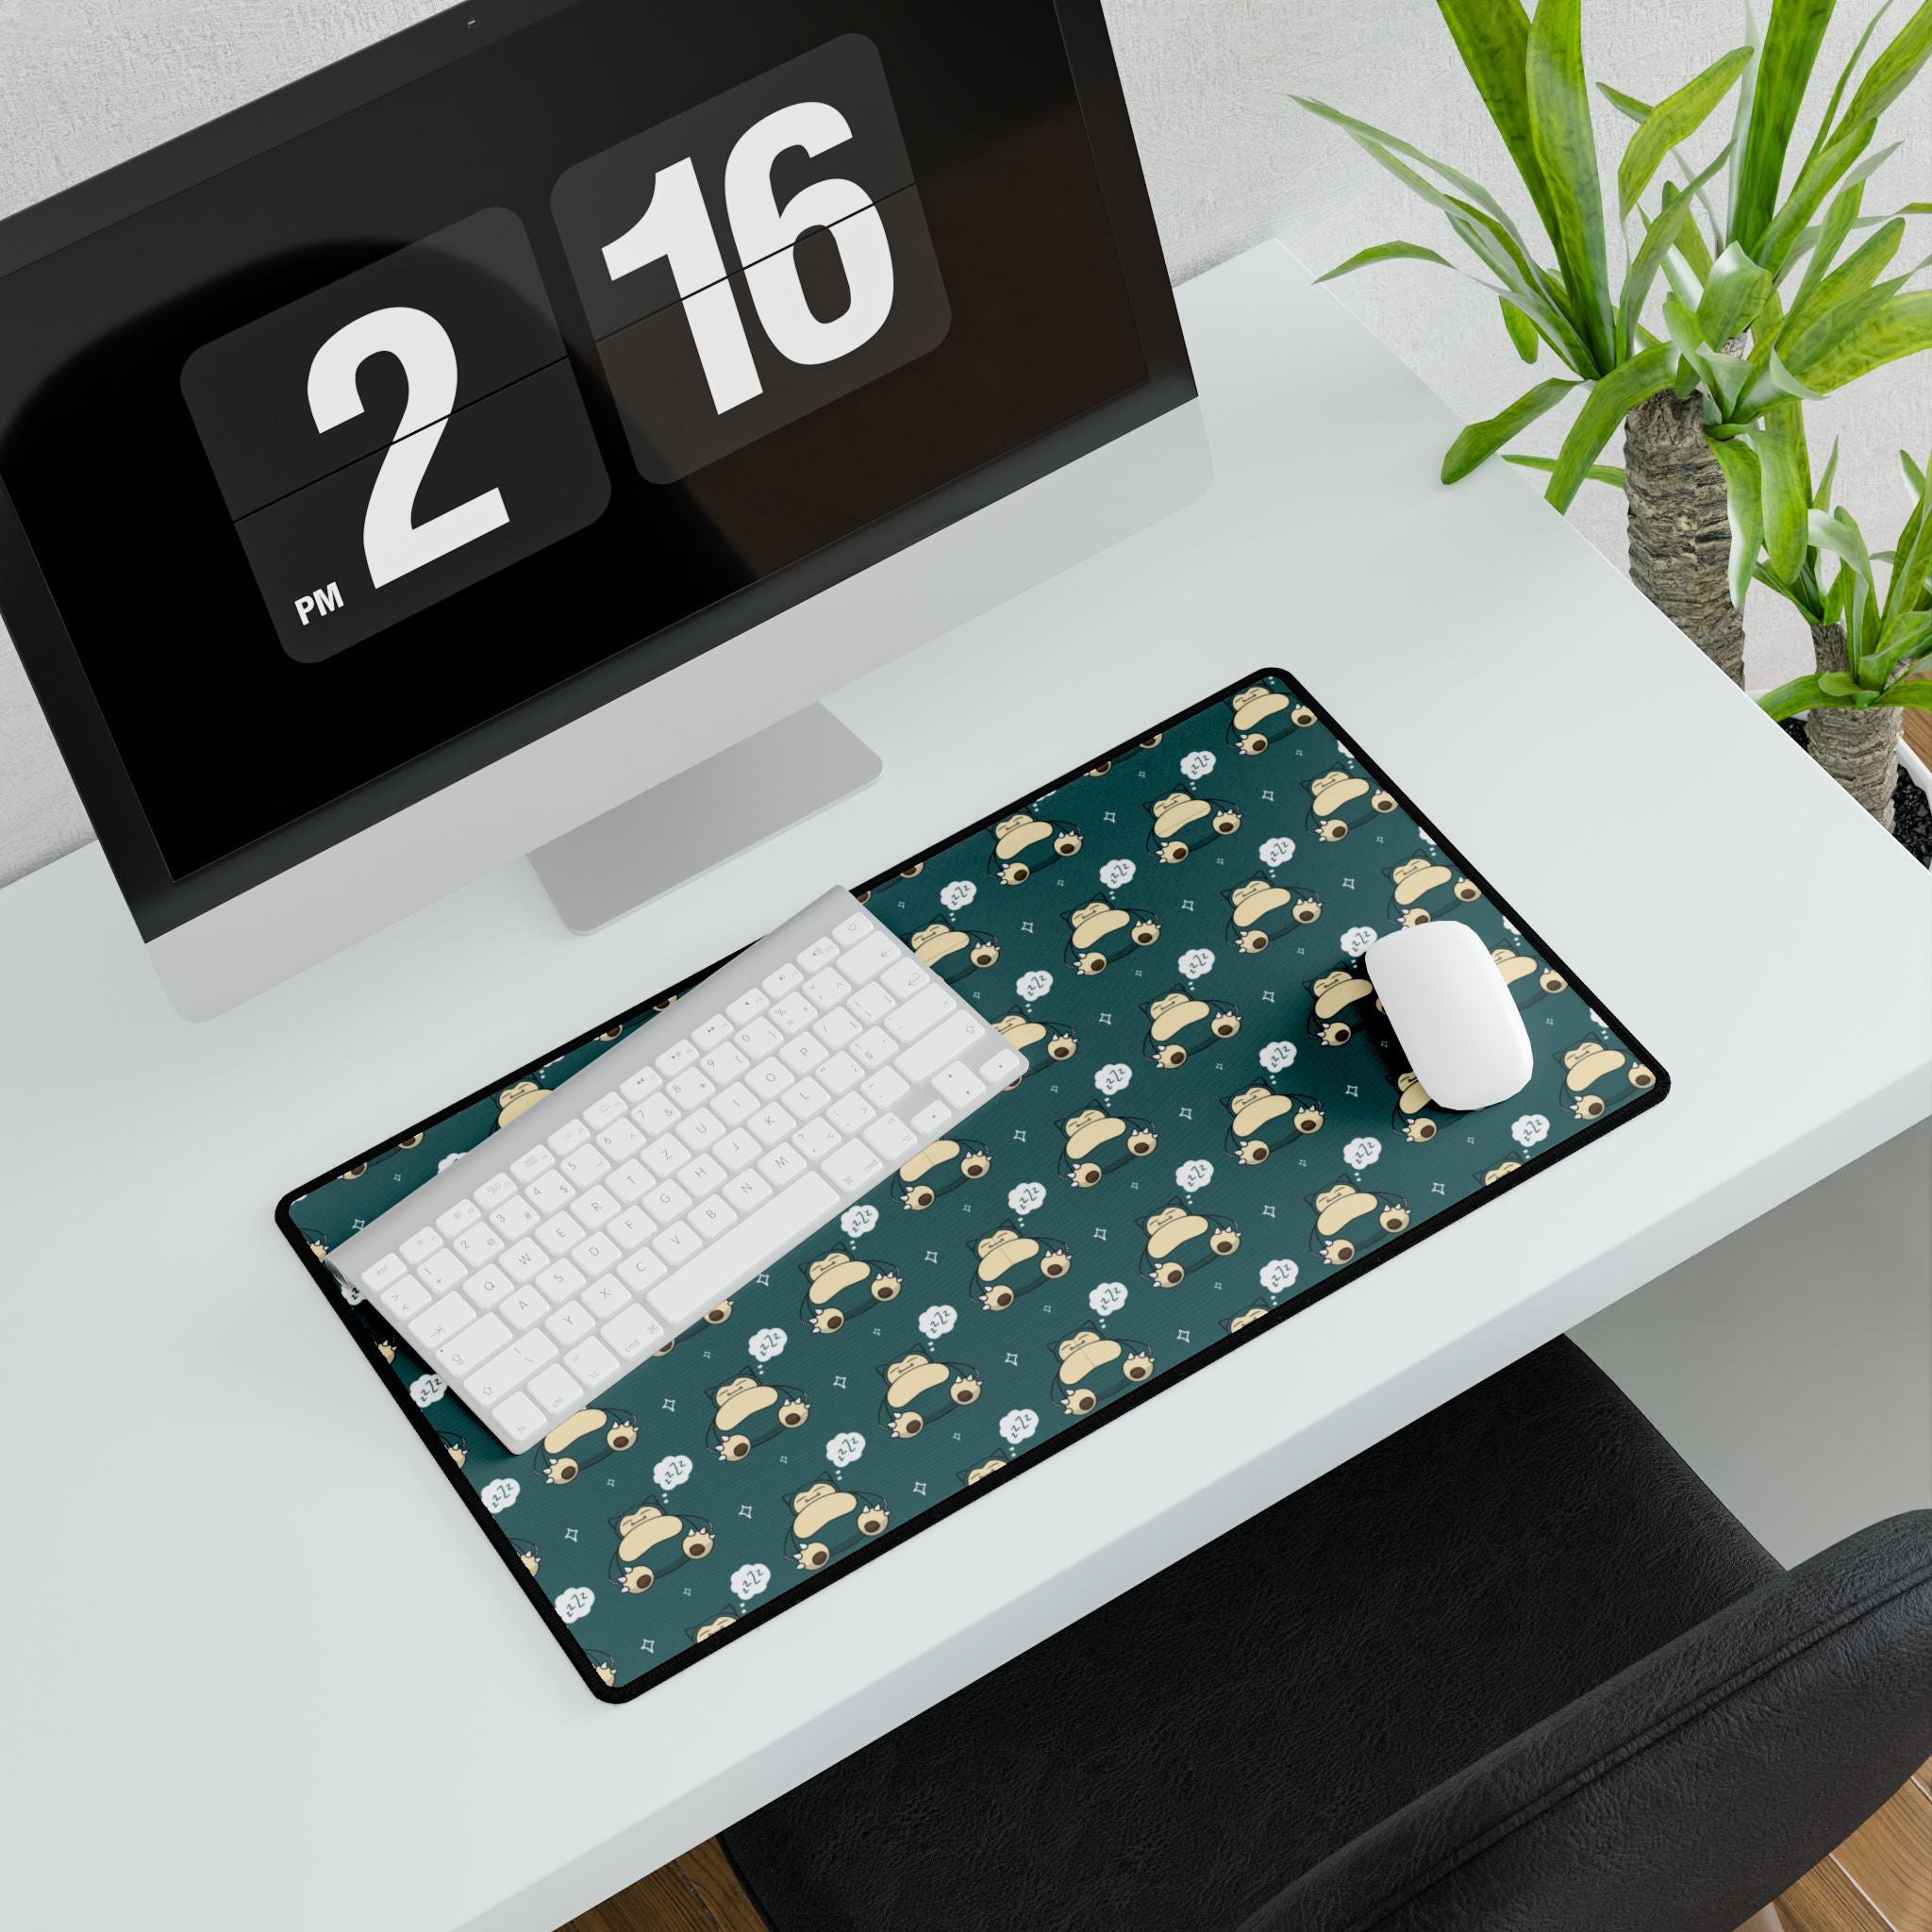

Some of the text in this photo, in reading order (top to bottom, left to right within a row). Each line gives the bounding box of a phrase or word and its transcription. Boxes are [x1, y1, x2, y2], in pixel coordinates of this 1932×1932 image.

[307, 102, 894, 589] 2 16
[294, 582, 343, 625] PM
[376, 1264, 390, 1275] esc
